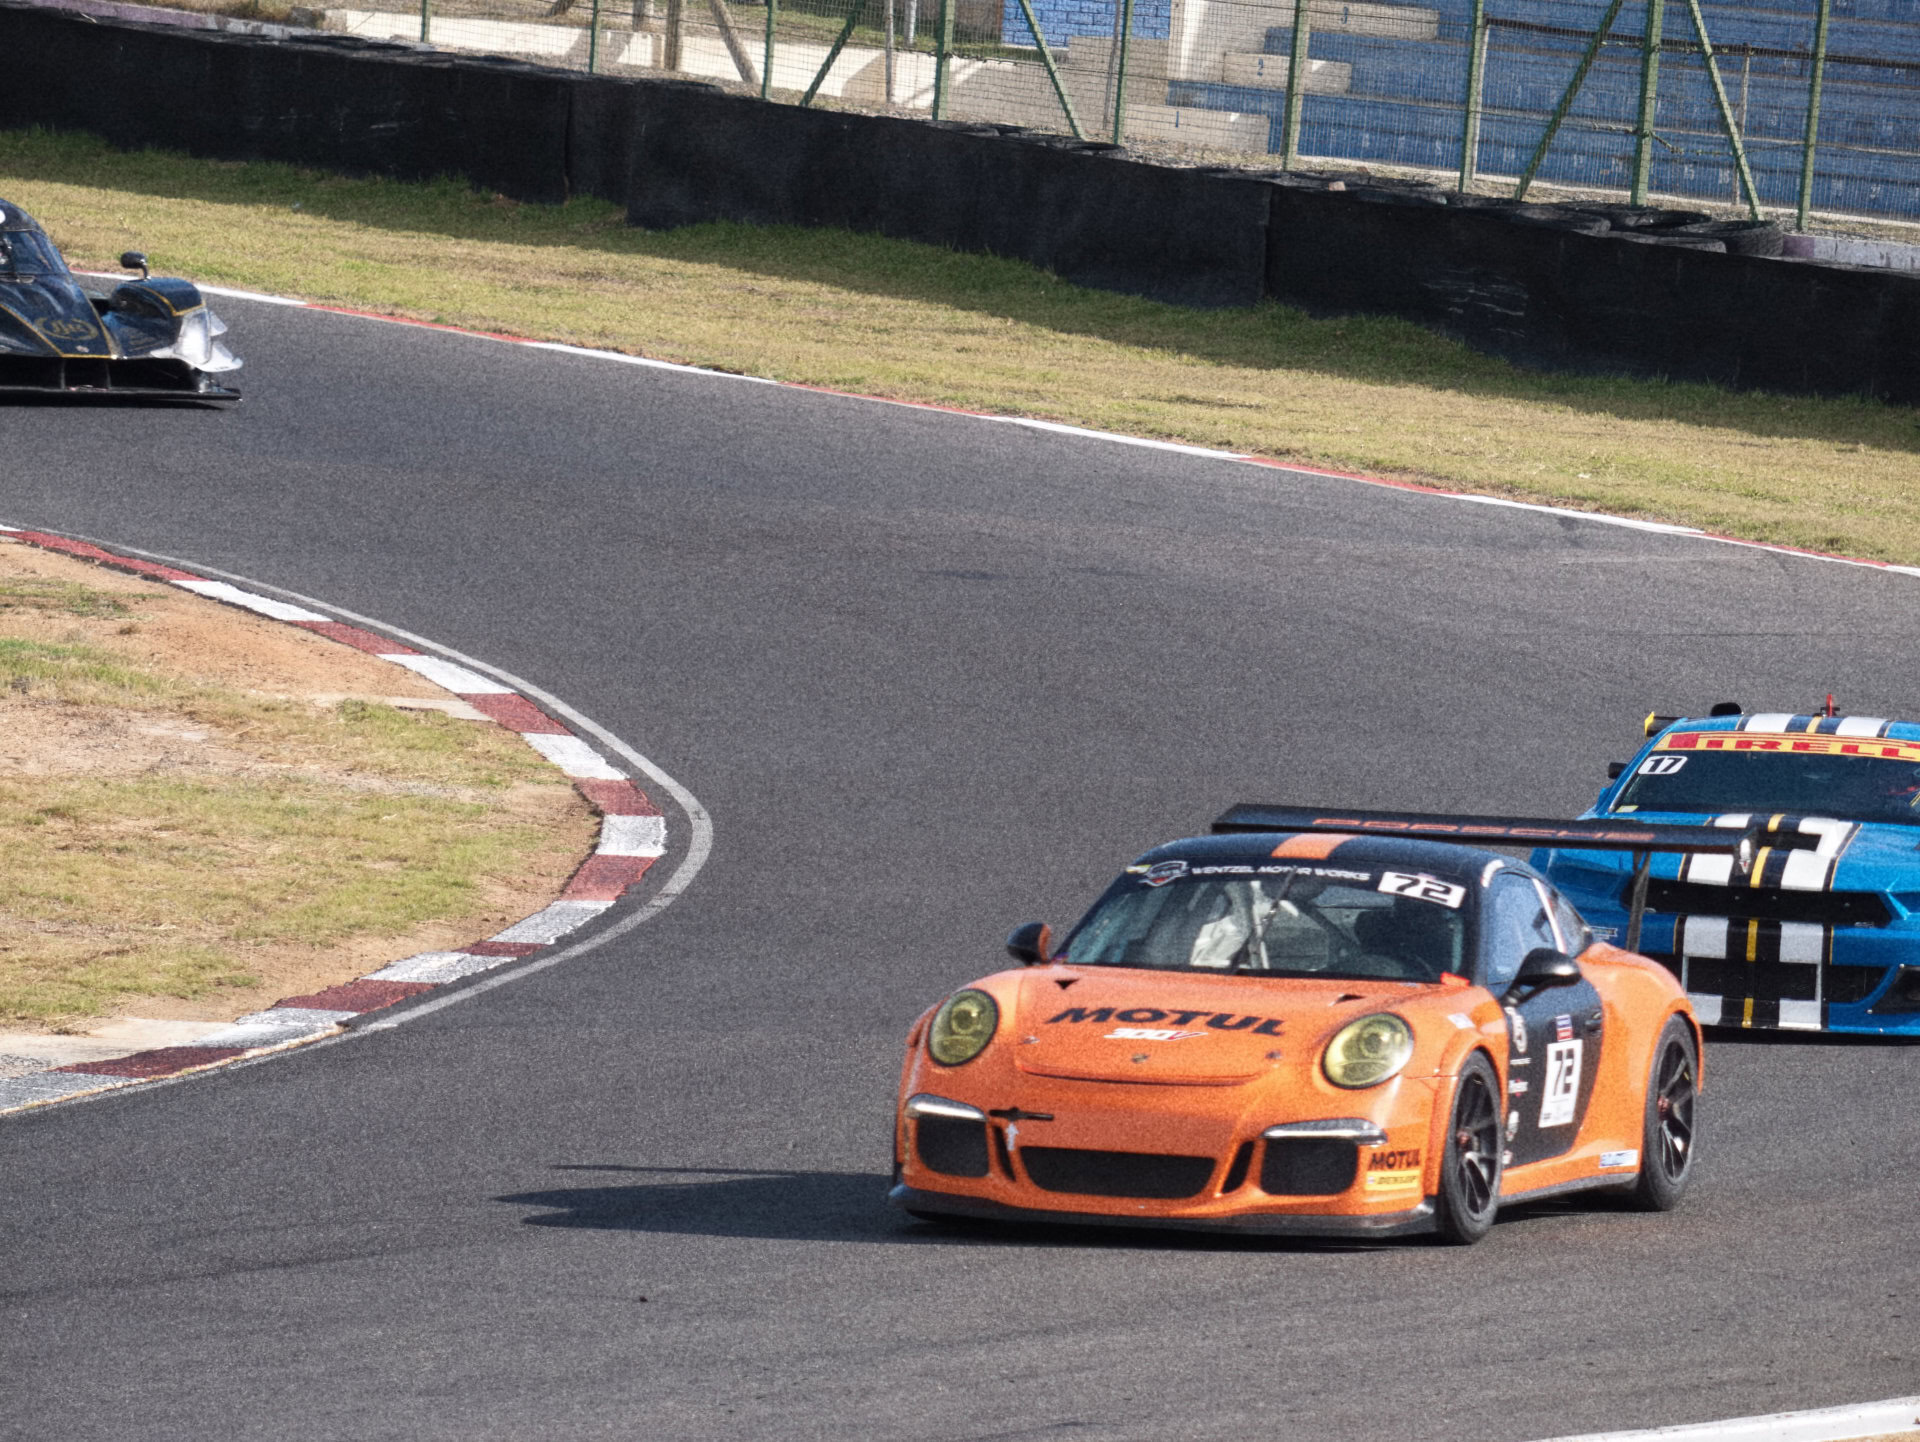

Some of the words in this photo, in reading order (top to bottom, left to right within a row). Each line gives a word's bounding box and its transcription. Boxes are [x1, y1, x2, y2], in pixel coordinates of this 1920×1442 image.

[1650, 757, 1682, 773] 17
[1314, 868, 1371, 882] WORKS
[1393, 874, 1452, 903] 72
[1045, 1007, 1285, 1037] MOTUL
[1104, 1027, 1208, 1041] 300V
